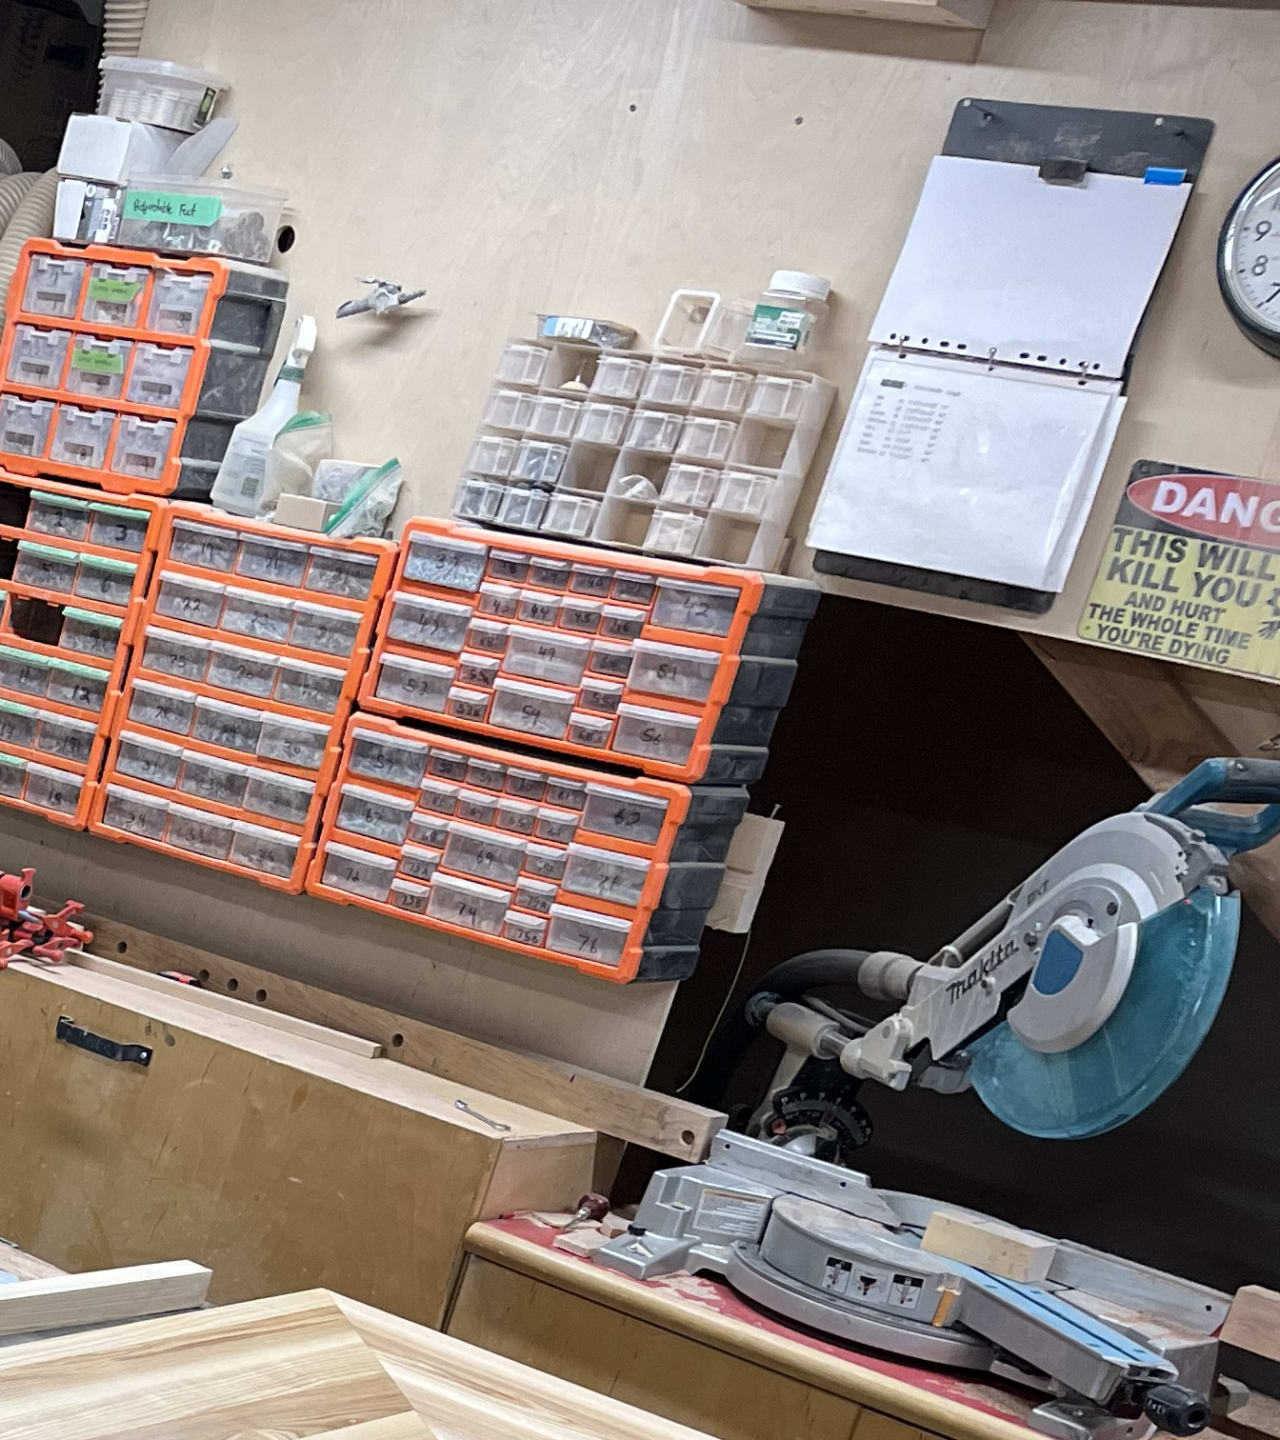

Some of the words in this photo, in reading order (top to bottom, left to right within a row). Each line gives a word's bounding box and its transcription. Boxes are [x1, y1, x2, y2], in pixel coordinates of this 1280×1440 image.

[1255, 220, 1272, 242] 9
[1252, 255, 1268, 276] 8
[116, 524, 127, 541] 3
[1113, 528, 1188, 563] THIS
[1197, 543, 1275, 581] WILL
[1106, 557, 1179, 593] KILL
[1193, 572, 1261, 608] YOU
[1124, 591, 1168, 611] AND
[1170, 600, 1226, 623] HURT
[1089, 603, 1126, 624] THE
[1131, 612, 1200, 638] WHOLE
[1204, 626, 1252, 650] TIME
[1097, 624, 1165, 651] YOU'RE
[1168, 639, 1230, 664] DYING
[458, 903, 477, 925] 74
[578, 934, 598, 953] 76
